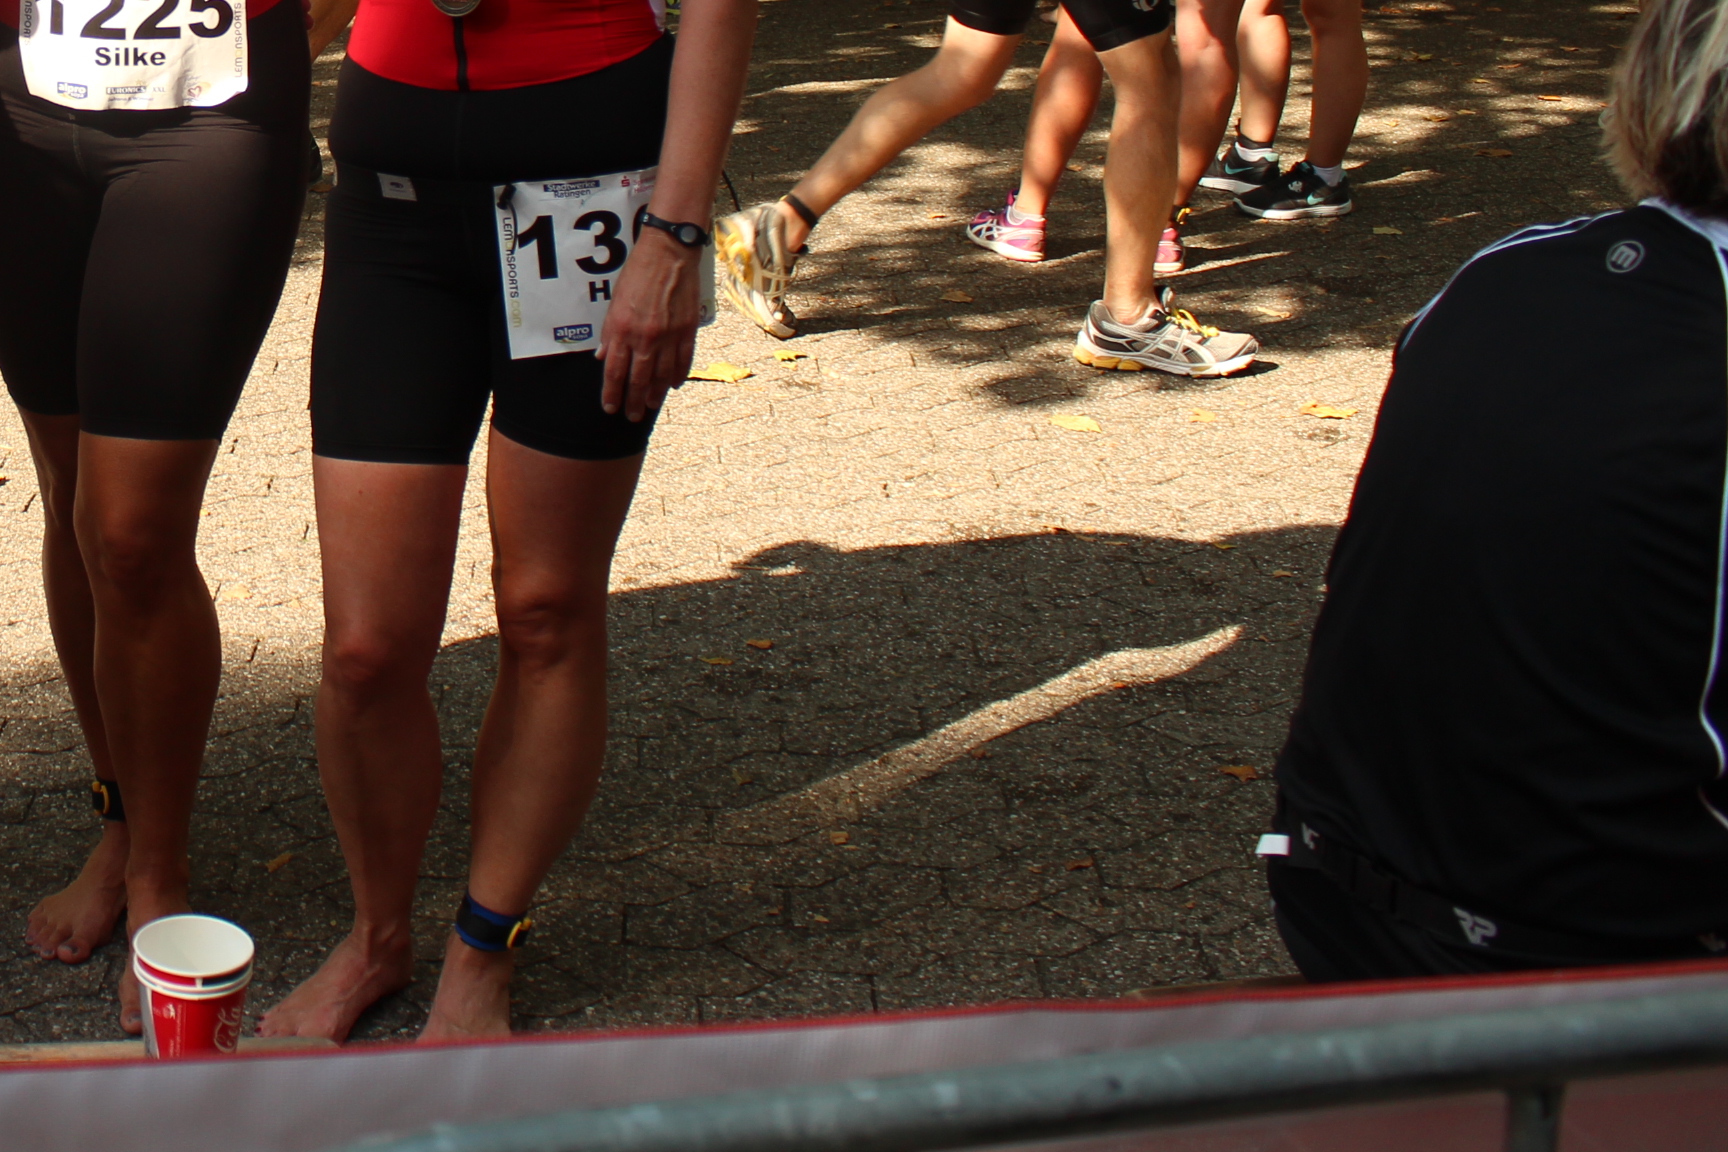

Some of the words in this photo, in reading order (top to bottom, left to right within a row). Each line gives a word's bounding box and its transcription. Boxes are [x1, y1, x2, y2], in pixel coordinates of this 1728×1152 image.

[95, 47, 166, 66] Silke
[59, 83, 87, 95] alpro
[557, 326, 590, 338] alpro
